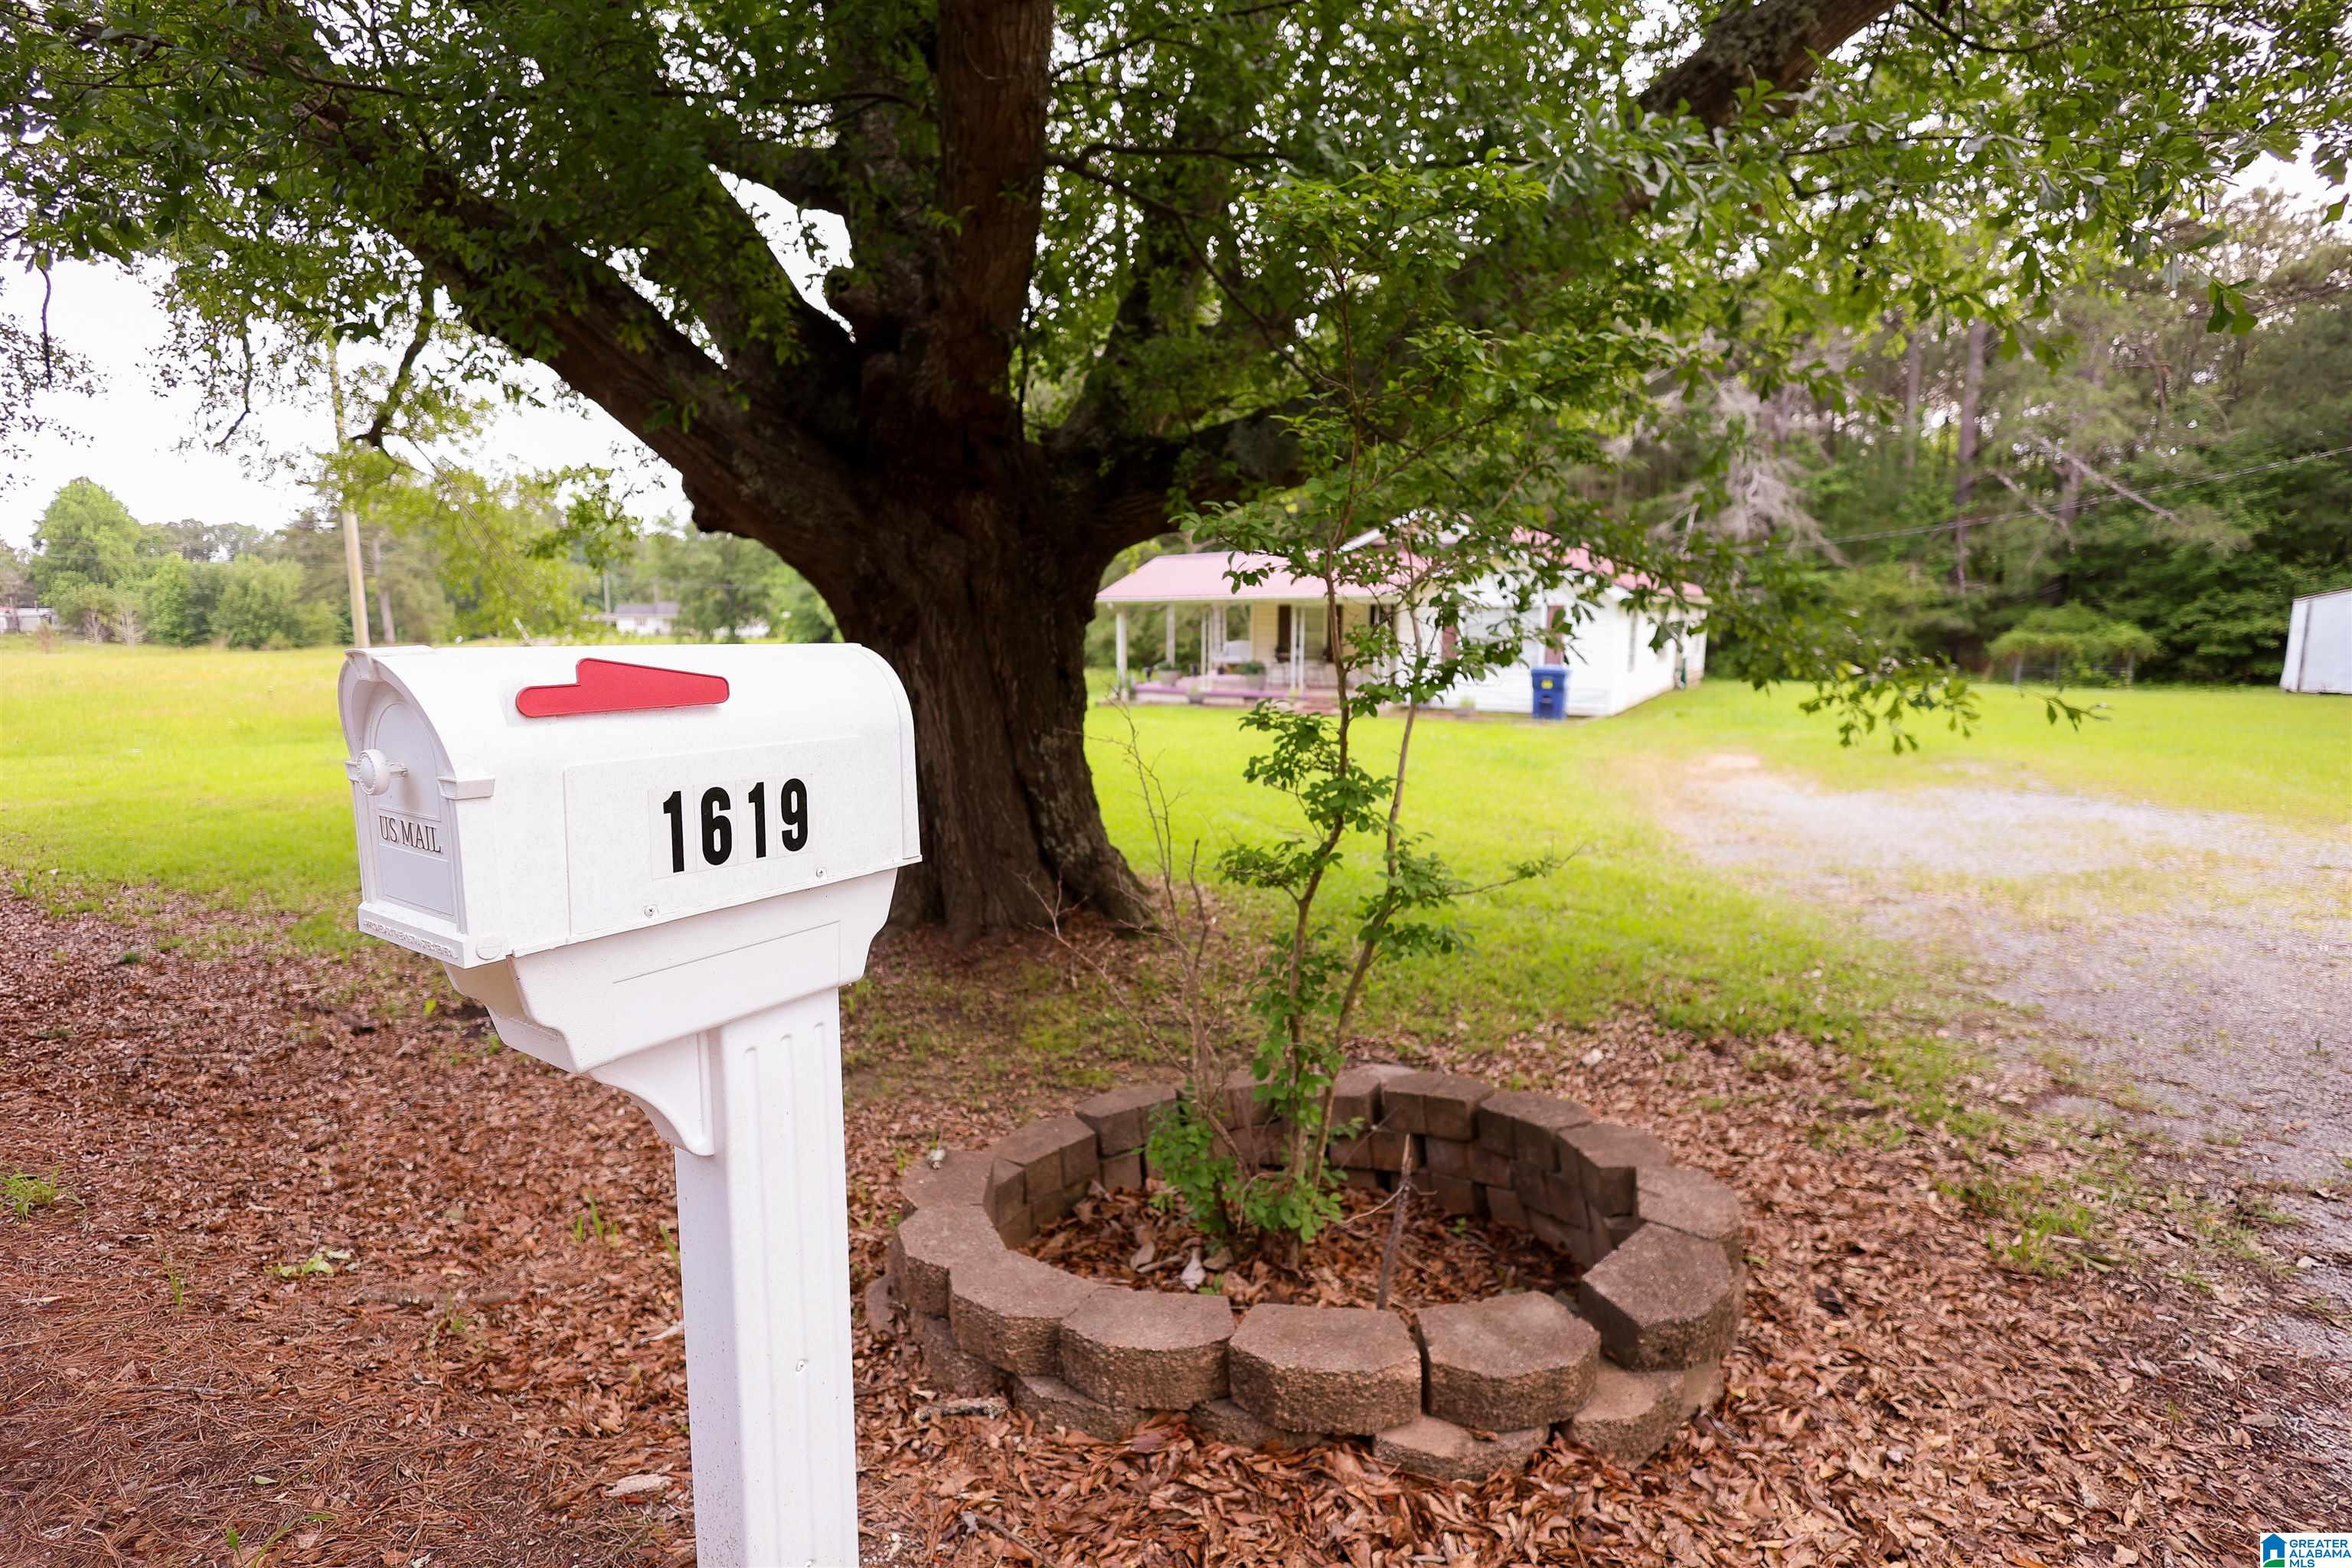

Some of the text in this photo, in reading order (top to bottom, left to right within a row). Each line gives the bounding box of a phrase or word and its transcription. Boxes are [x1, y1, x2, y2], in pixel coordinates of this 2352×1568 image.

[379, 815, 443, 854] US MAIL
[662, 778, 808, 874] 1619
